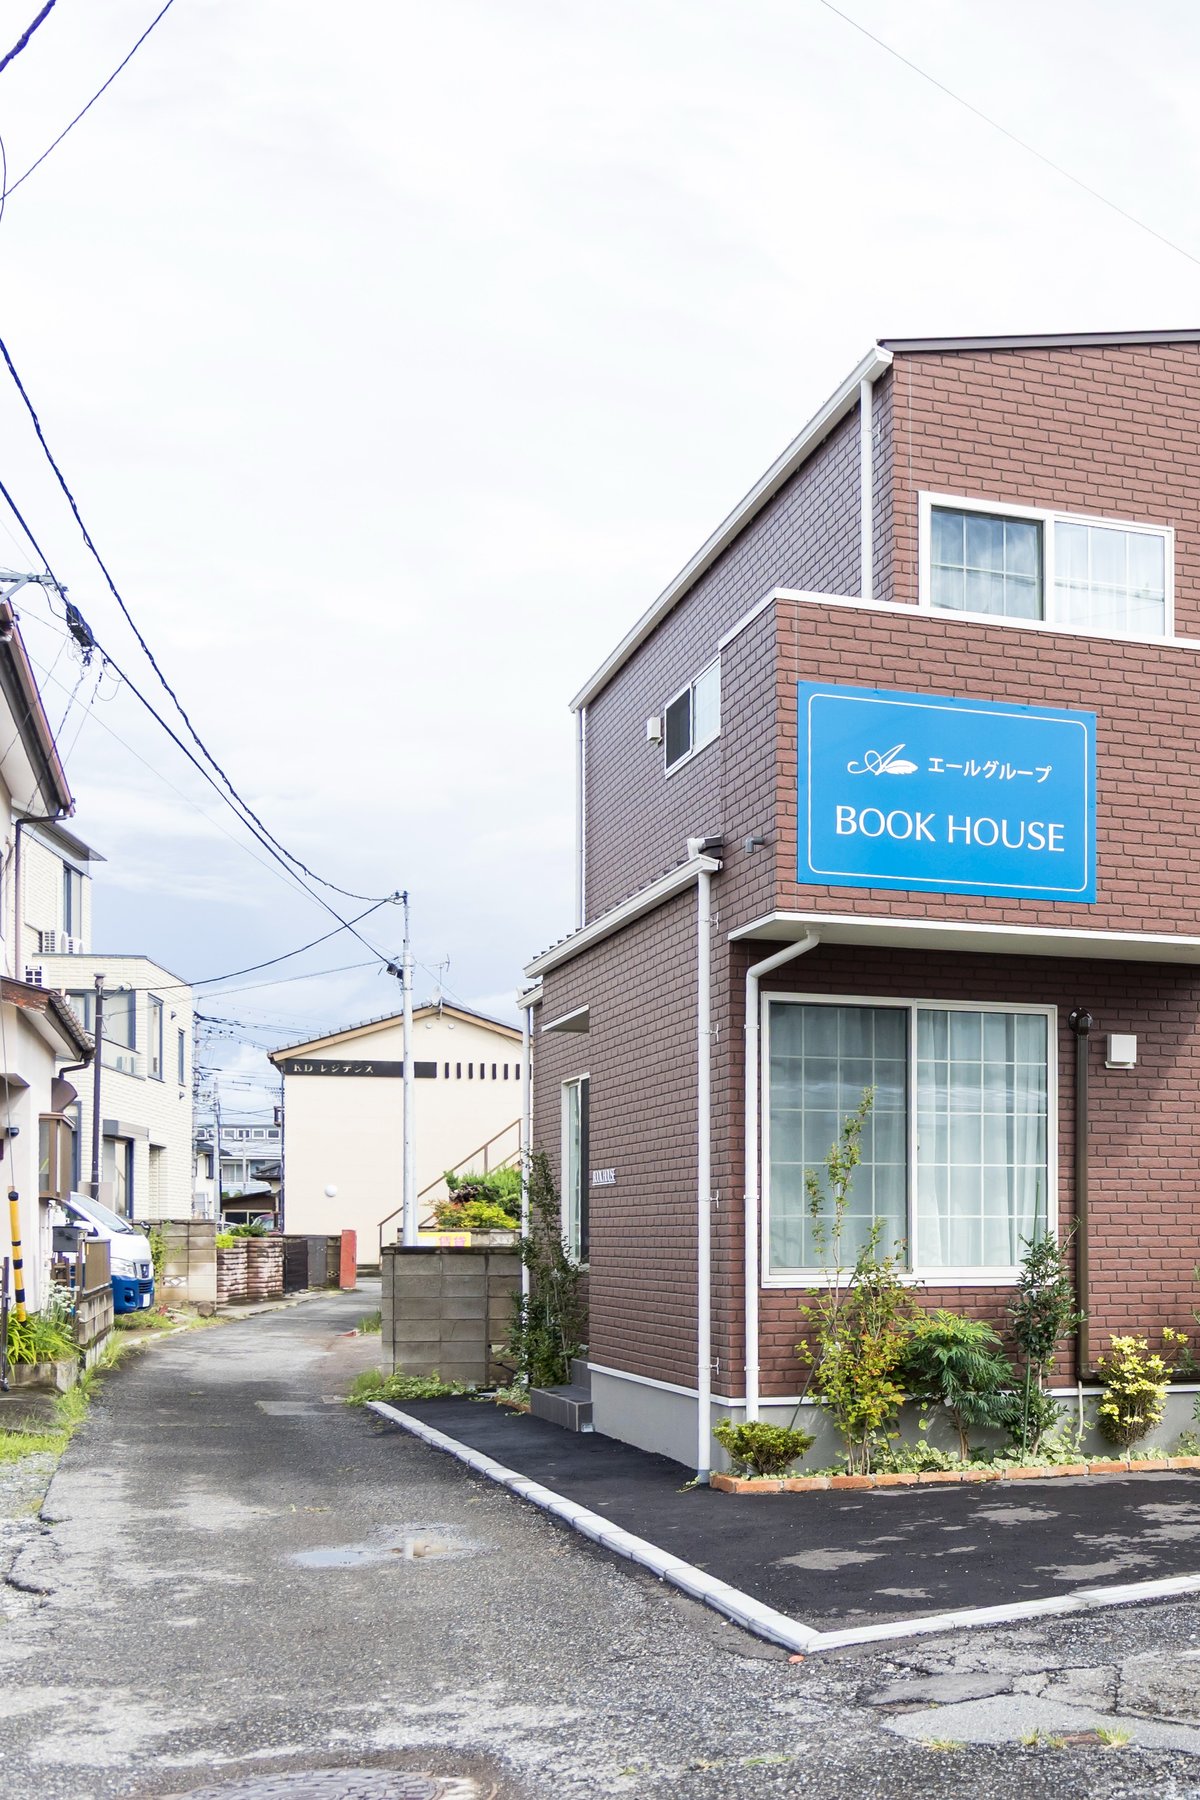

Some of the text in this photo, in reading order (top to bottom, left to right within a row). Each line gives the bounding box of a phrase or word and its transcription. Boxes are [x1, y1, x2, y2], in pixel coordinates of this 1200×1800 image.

[927, 757, 1053, 784] エールグループ
[836, 805, 1065, 852] BOOK HOUSE
[293, 1063, 313, 1072] KD
